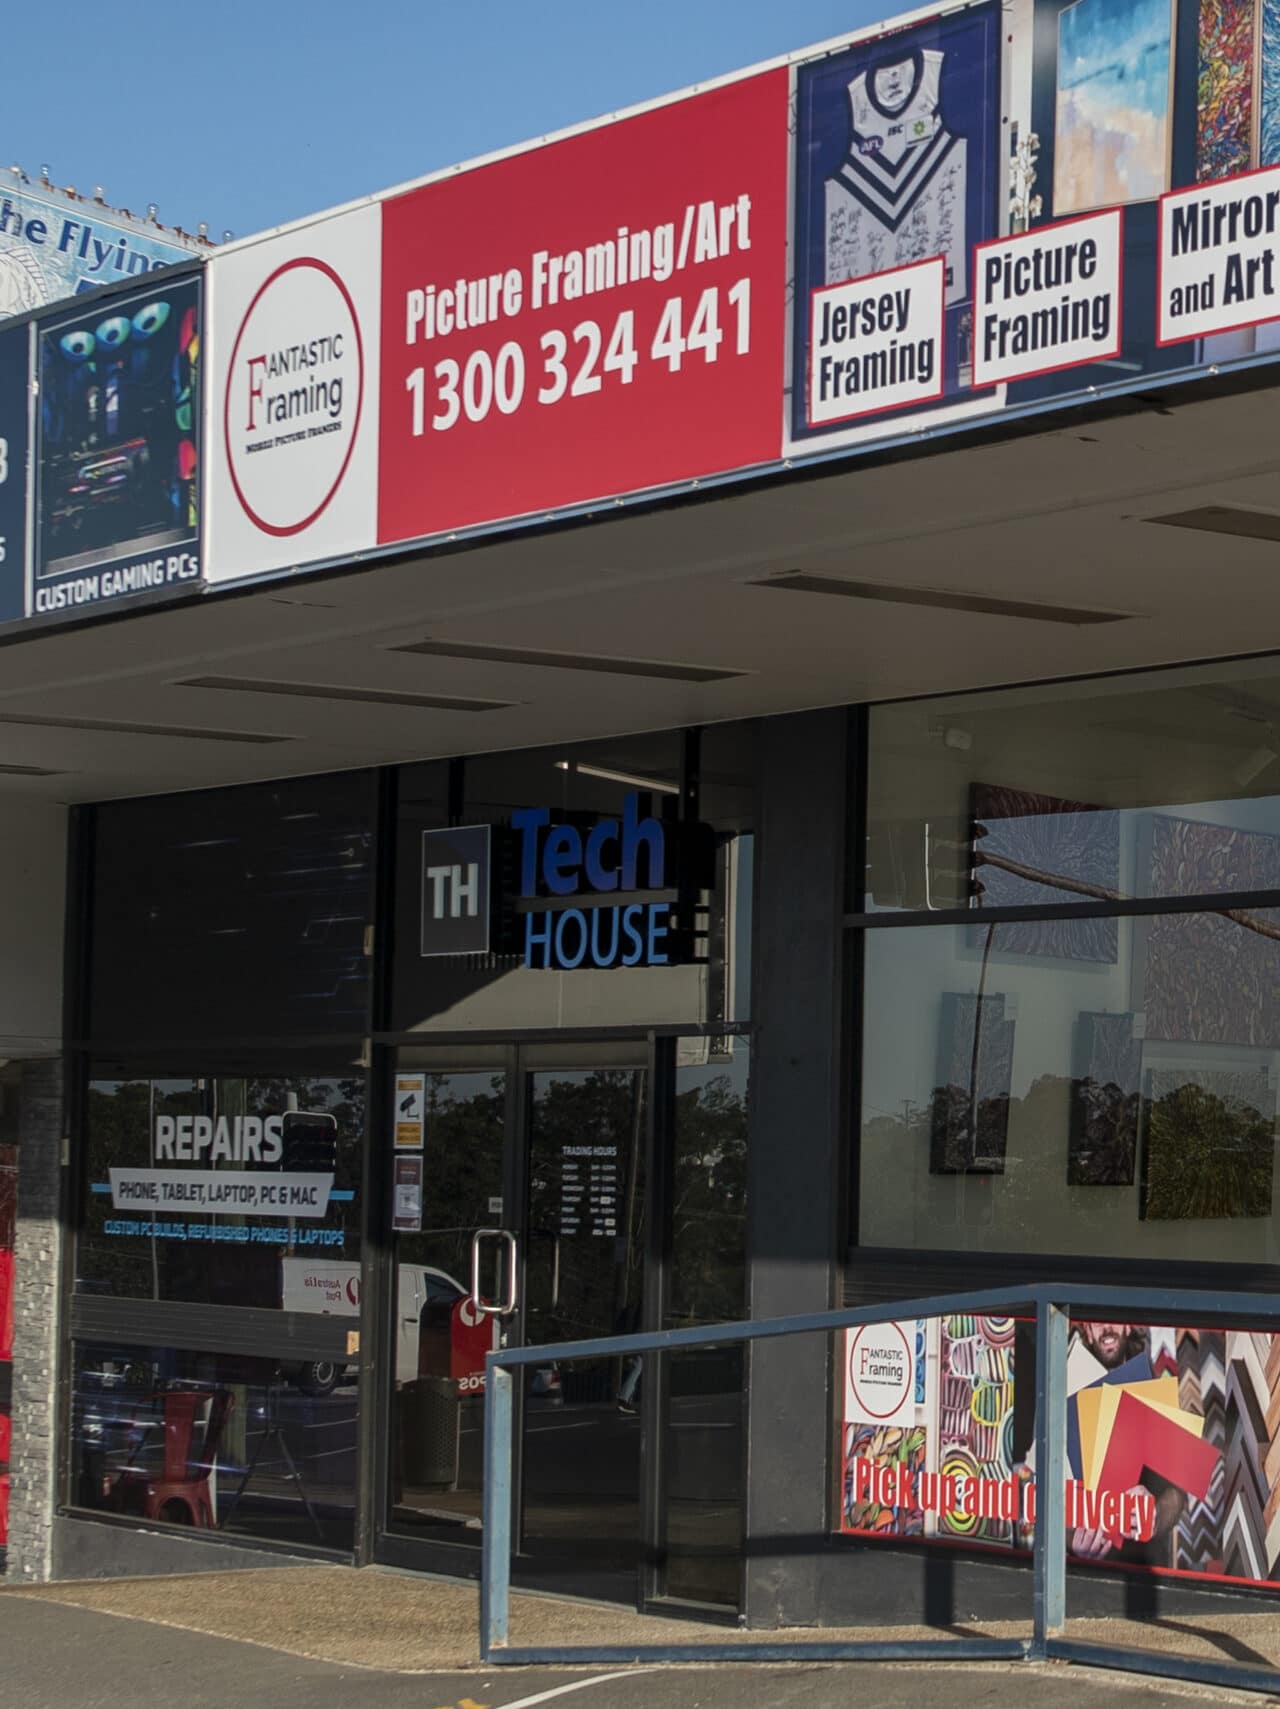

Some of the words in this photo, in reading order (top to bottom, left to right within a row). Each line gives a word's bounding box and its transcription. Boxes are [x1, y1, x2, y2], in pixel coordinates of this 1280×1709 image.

[861, 138, 881, 152] AFL
[0, 197, 47, 245] he
[406, 268, 523, 345] Picture
[531, 194, 752, 310] Framing/Art
[985, 238, 1097, 305] Picture
[1169, 274, 1216, 318] and
[1223, 249, 1275, 306] Art
[819, 288, 912, 347] Jersey
[984, 292, 1111, 363] Framing
[246, 333, 343, 379] FANTASTIC
[405, 340, 526, 437] 1300
[537, 310, 639, 404] 324
[651, 278, 751, 373] 441
[819, 335, 935, 401] Framing
[246, 374, 343, 431] Framing
[36, 575, 99, 612] CUSTOM
[100, 560, 164, 597] GAMING
[166, 553, 199, 581] PCs
[511, 791, 665, 896] Tech
[427, 863, 479, 919] TH
[524, 903, 670, 969] HOUSE
[155, 1115, 283, 1162] REPAIRS
[119, 1182, 160, 1202] PHONE,
[162, 1183, 205, 1205] TABLET,
[208, 1185, 258, 1207] LAPTOP,
[260, 1188, 276, 1204] PC
[279, 1188, 287, 1204] &
[289, 1189, 318, 1205] MAC
[250, 1226, 289, 1243] PHONES
[298, 1229, 343, 1246] LAPTOPS
[854, 1455, 914, 1509] Pick
[918, 1470, 956, 1518] up
[962, 1472, 1019, 1521] and
